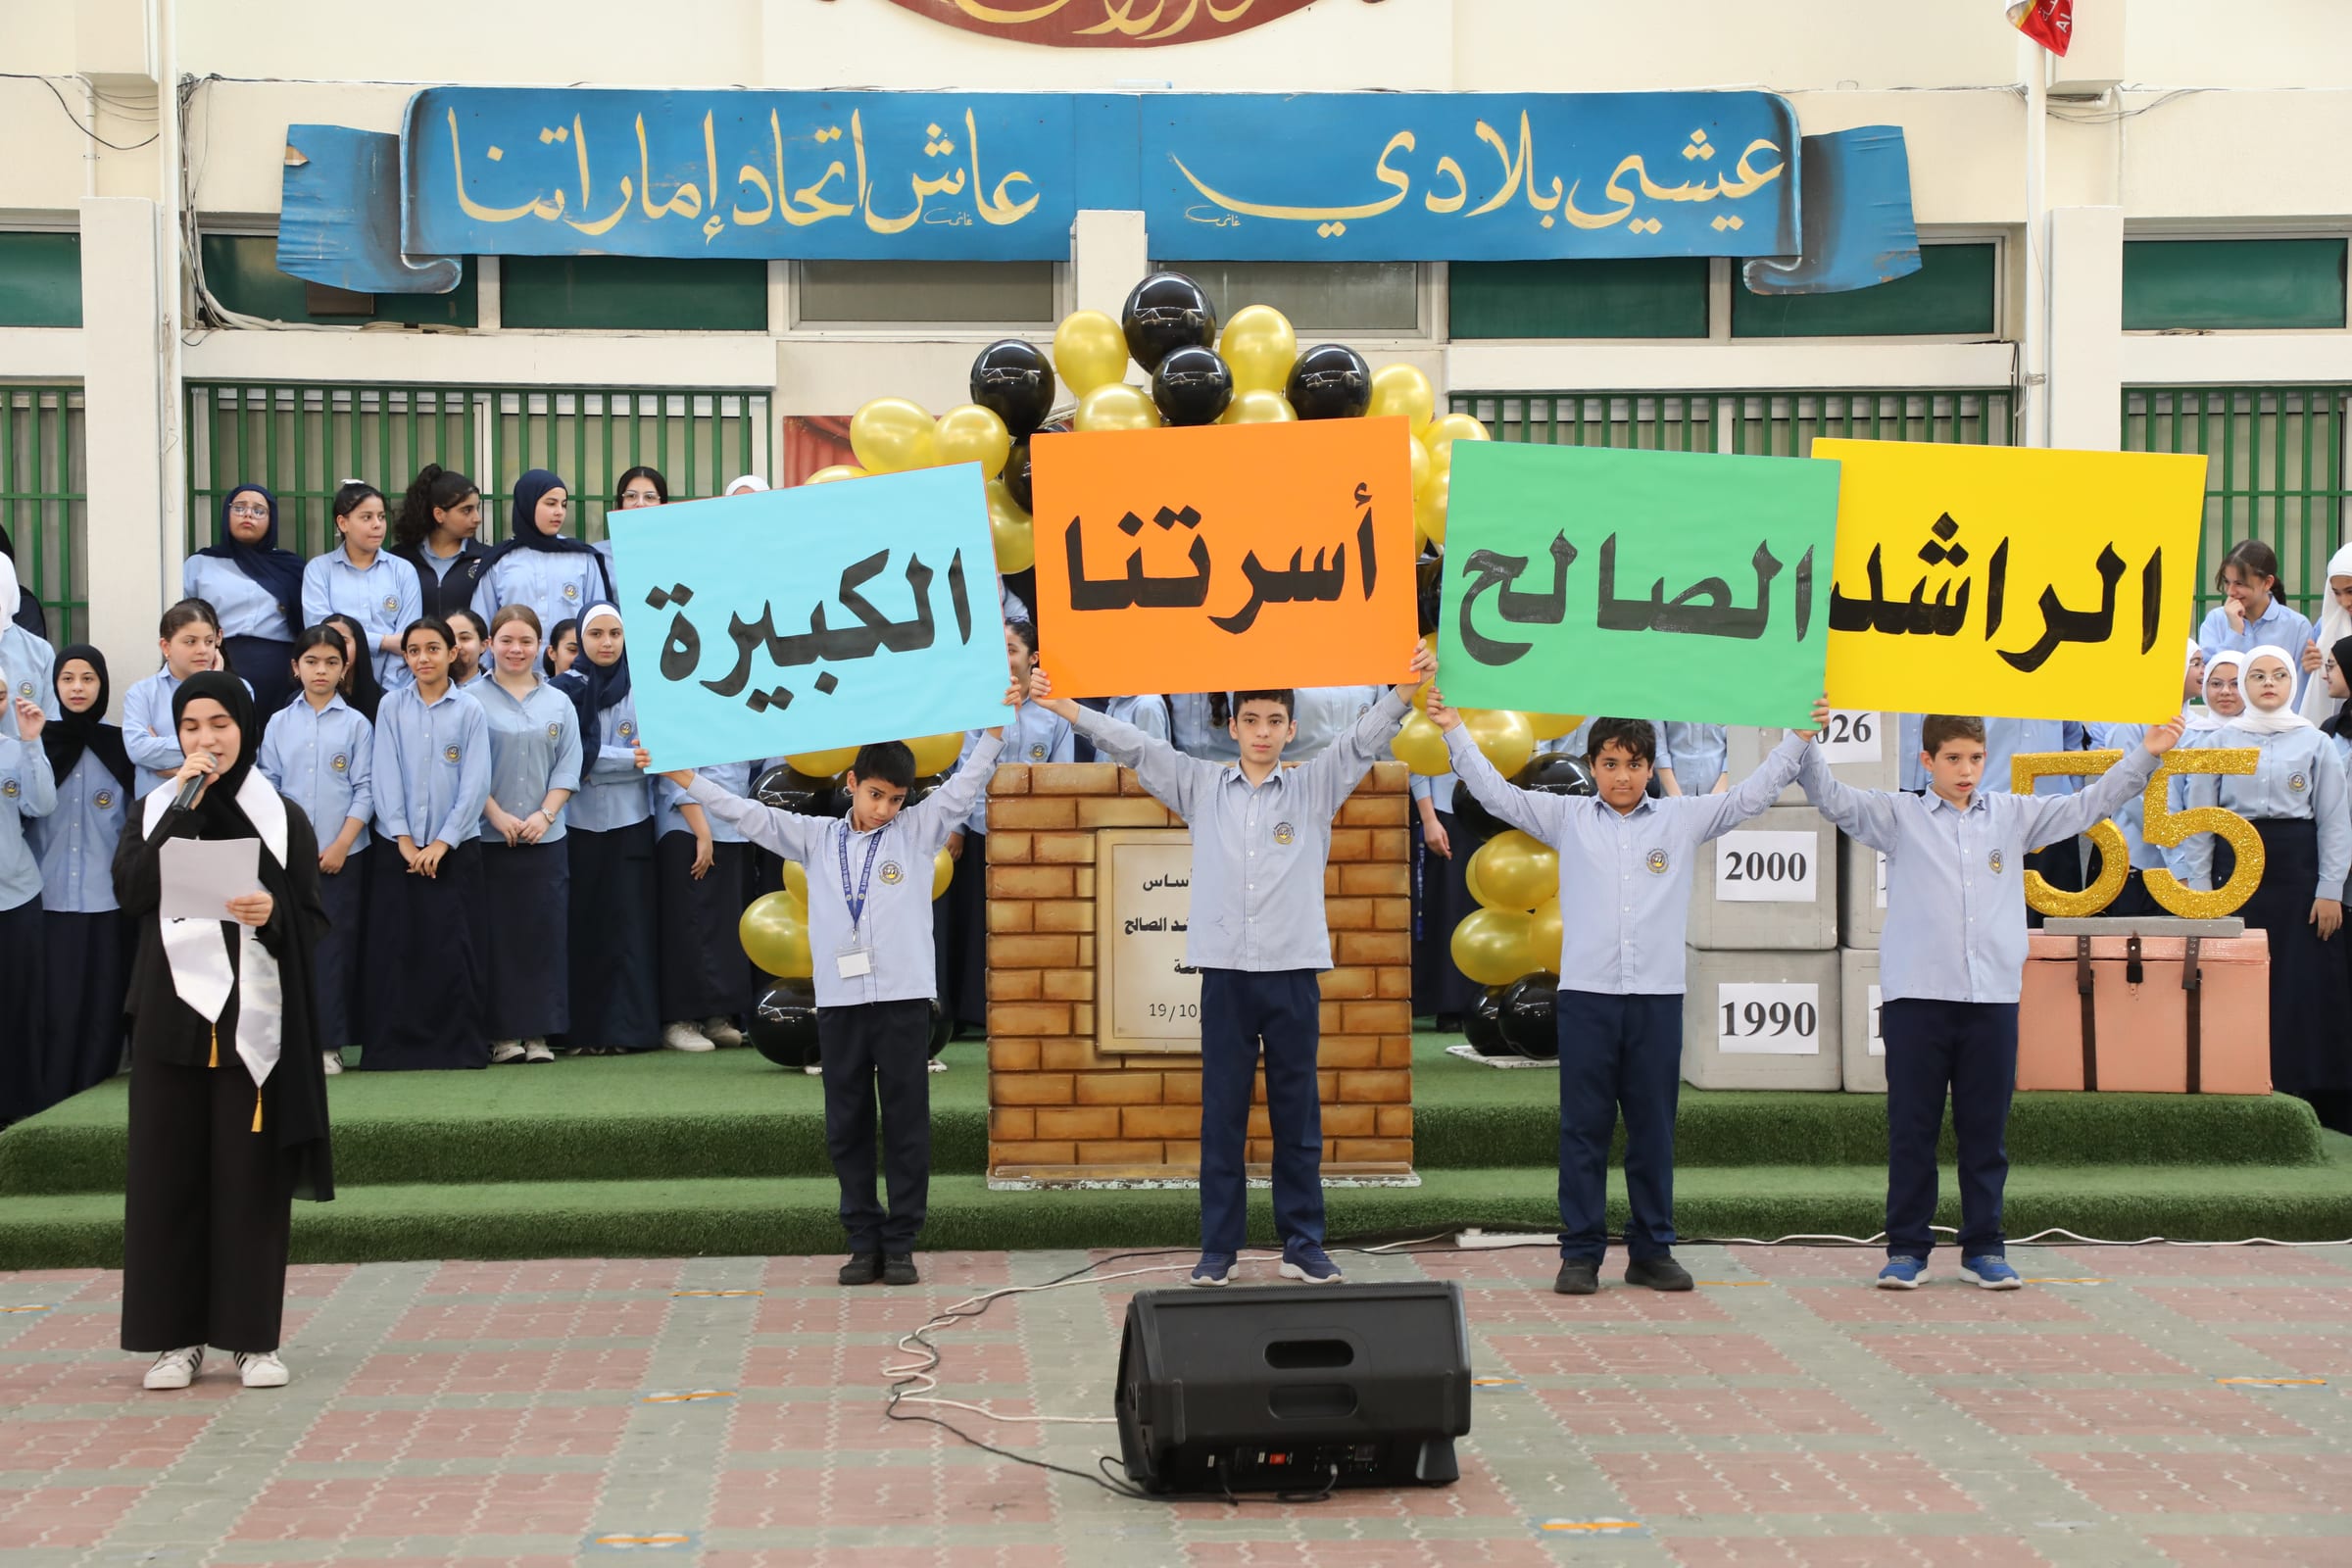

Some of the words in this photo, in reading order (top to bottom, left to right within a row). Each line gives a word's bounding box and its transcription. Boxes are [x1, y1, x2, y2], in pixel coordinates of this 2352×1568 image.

[448, 107, 723, 245] إماراتنا
[732, 108, 866, 226] اتحاد
[863, 107, 1040, 235] عاش
[1170, 109, 1564, 238] بلادي
[1564, 128, 1786, 235] عيشي
[1064, 481, 1377, 635] أسرتنا
[1459, 527, 1814, 667] الصالح
[1829, 511, 2162, 673] الراشد
[644, 547, 972, 713] الكبيرة
[1815, 713, 1872, 744] 026
[1725, 852, 1807, 882] 2000
[2011, 747, 2266, 919] 55
[1124, 916, 1168, 936] الصالح
[1722, 1001, 1817, 1038] 1990
